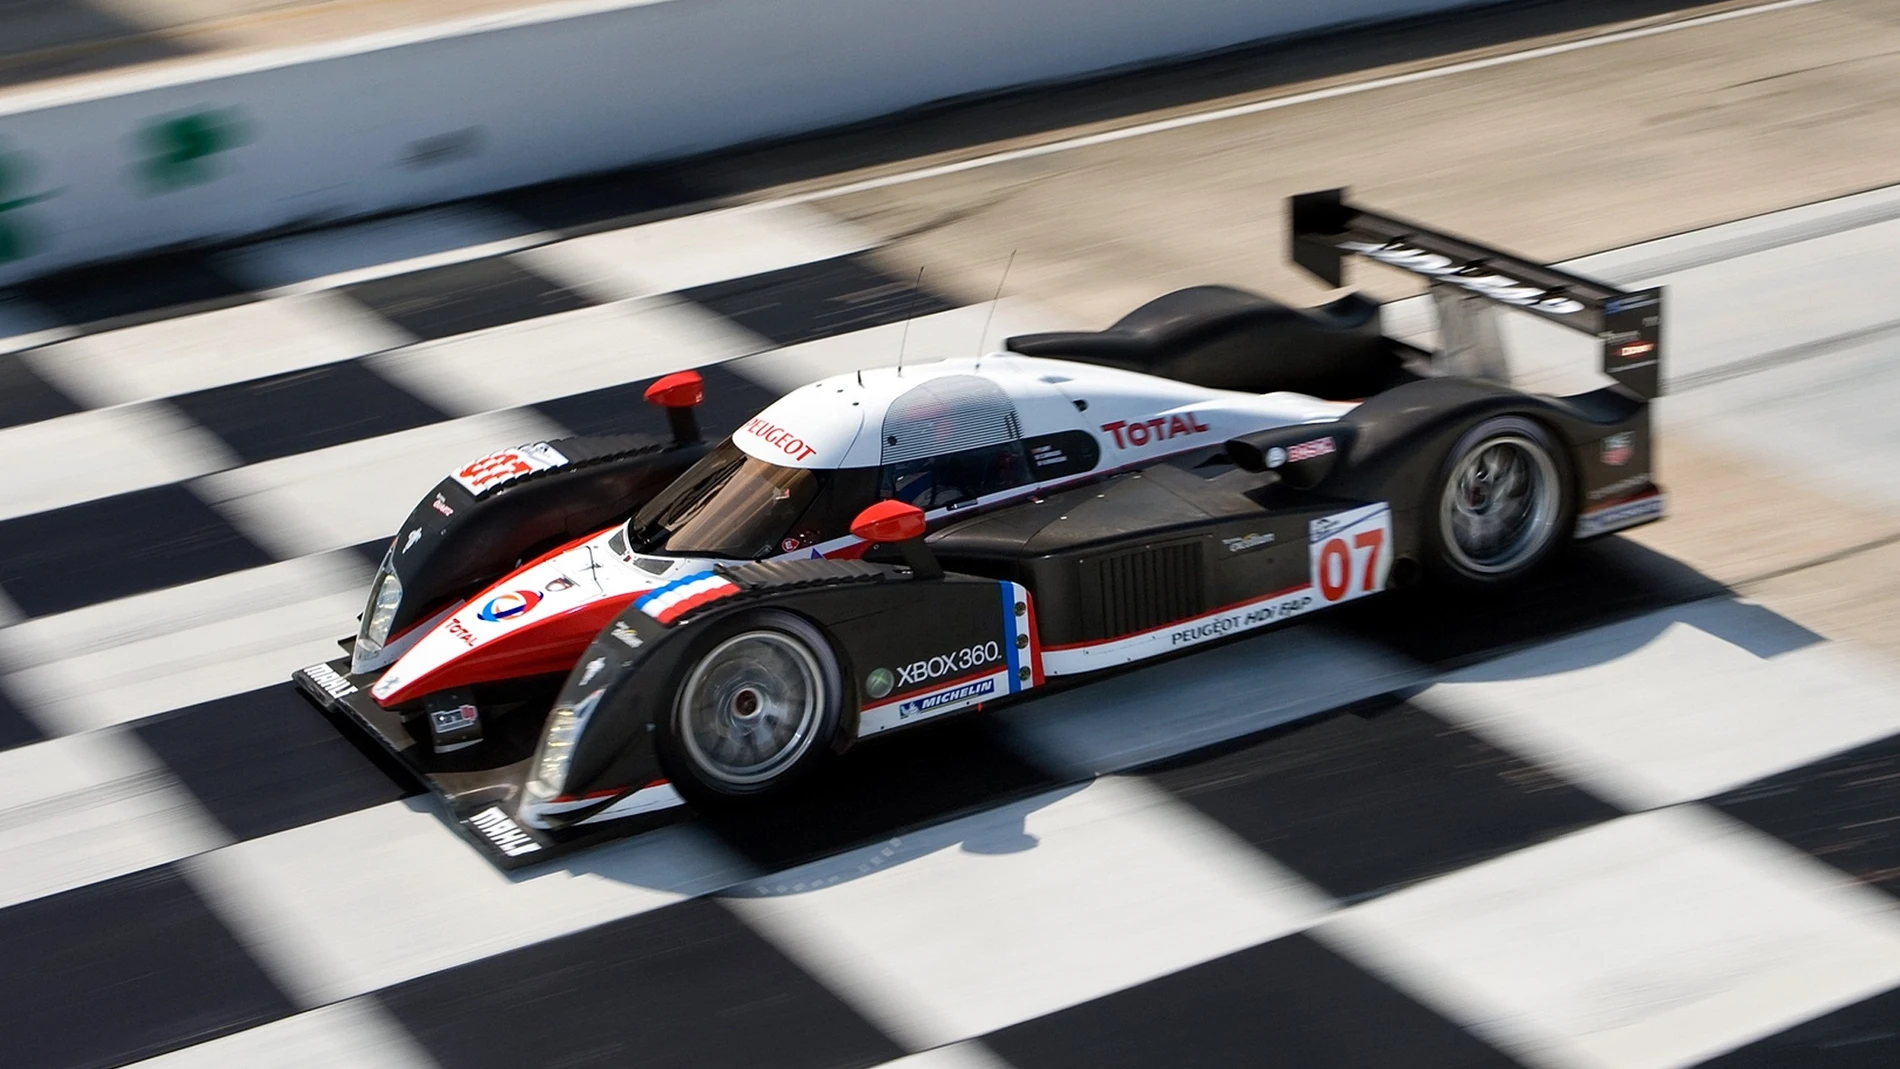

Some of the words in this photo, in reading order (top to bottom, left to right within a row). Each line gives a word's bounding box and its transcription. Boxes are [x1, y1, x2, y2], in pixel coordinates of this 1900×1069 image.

[741, 418, 817, 462] PEUGEOT
[1100, 411, 1209, 450] TOTAL
[1319, 527, 1385, 603] 07
[445, 618, 478, 647] TOTAL
[1172, 614, 1241, 645] PEUGEOT
[303, 662, 359, 699] MAHLE
[897, 651, 958, 688] XBOX
[921, 680, 993, 710] MICHELIN
[468, 806, 543, 857] MAHLE
